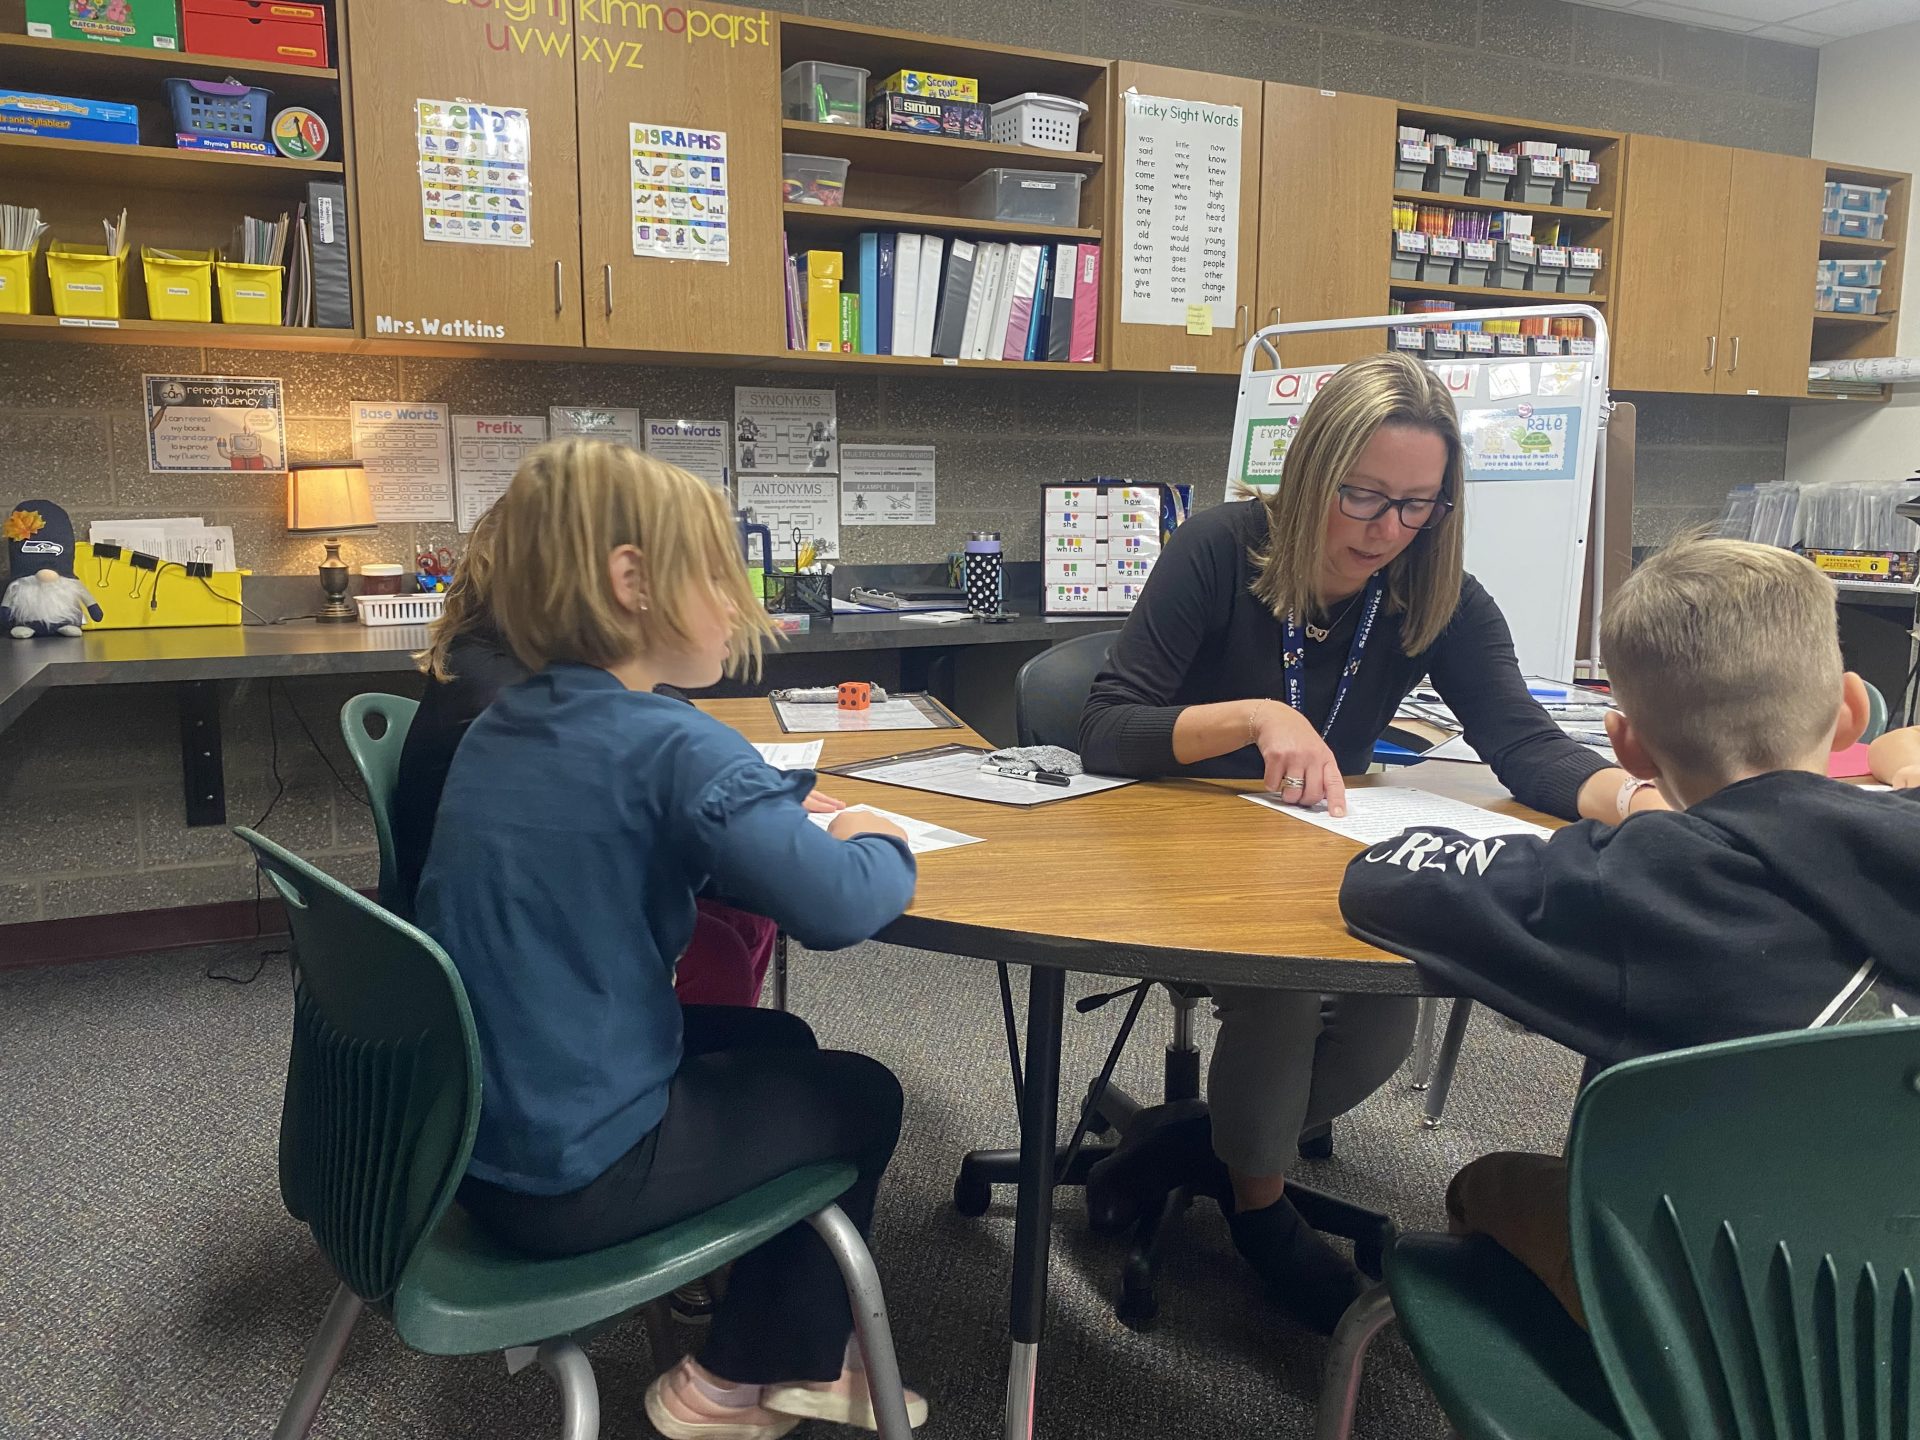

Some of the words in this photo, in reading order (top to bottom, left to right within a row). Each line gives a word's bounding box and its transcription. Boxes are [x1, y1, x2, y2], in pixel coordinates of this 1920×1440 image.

[1170, 106, 1199, 124] Sight
[1202, 110, 1239, 128] Words
[230, 140, 266, 152] BINGO
[1138, 147, 1153, 155] said
[1136, 158, 1155, 167] there
[1208, 154, 1227, 163] know
[1176, 162, 1189, 171] why
[1208, 166, 1226, 175] knew
[1136, 183, 1154, 191] some
[1209, 178, 1224, 187] their
[1136, 194, 1152, 205] they
[1209, 190, 1224, 200] high
[1207, 201, 1225, 212] along
[1206, 213, 1225, 222] heard
[1136, 219, 1151, 229] only
[1205, 237, 1225, 247] young
[1133, 242, 1153, 252] down
[1204, 249, 1226, 258] among
[1203, 260, 1225, 269] people
[1135, 279, 1149, 288] give
[1202, 283, 1225, 292] change
[1133, 290, 1150, 298] have
[1204, 294, 1221, 303] point
[1276, 374, 1301, 398] a
[161, 390, 182, 399] can
[186, 386, 223, 394] reread
[225, 386, 234, 395] to
[236, 386, 275, 397] improve
[202, 397, 219, 406] my
[750, 394, 820, 406] SYNONYMS
[360, 408, 392, 419] Base
[396, 408, 439, 420] Words
[476, 420, 523, 434] Prefix
[651, 424, 679, 436] Root
[684, 426, 721, 437] Words
[753, 483, 822, 495] ANTONYMS
[1359, 590, 1382, 648] SEAHAWKS
